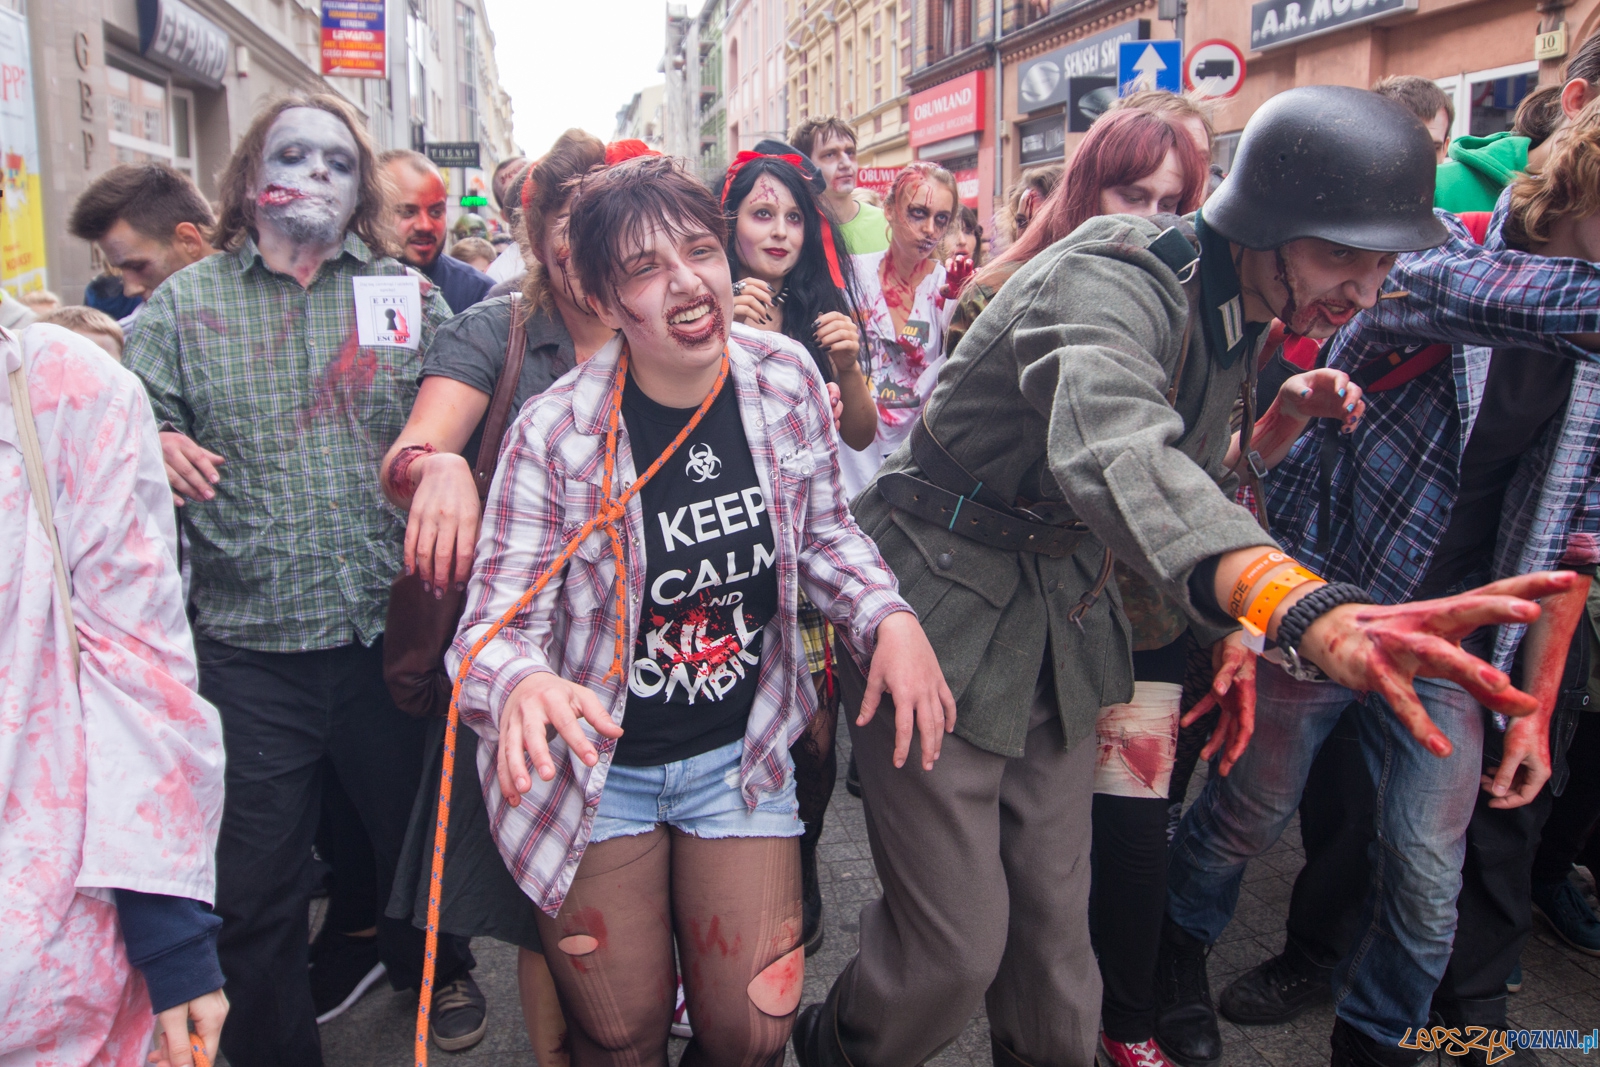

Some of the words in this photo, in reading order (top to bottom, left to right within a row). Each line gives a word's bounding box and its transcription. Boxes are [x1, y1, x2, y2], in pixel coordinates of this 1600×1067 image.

[153, 11, 229, 80] GEPARD
[1064, 43, 1099, 79] SENSEI
[1101, 32, 1132, 69] SH
[1541, 35, 1555, 49] 10
[913, 87, 972, 121] OBUWLAND
[430, 148, 477, 158] TRENDY
[859, 169, 900, 182] OBUWL
[657, 485, 767, 553] KEEP
[650, 543, 777, 606] CALM
[645, 602, 766, 665] KILL
